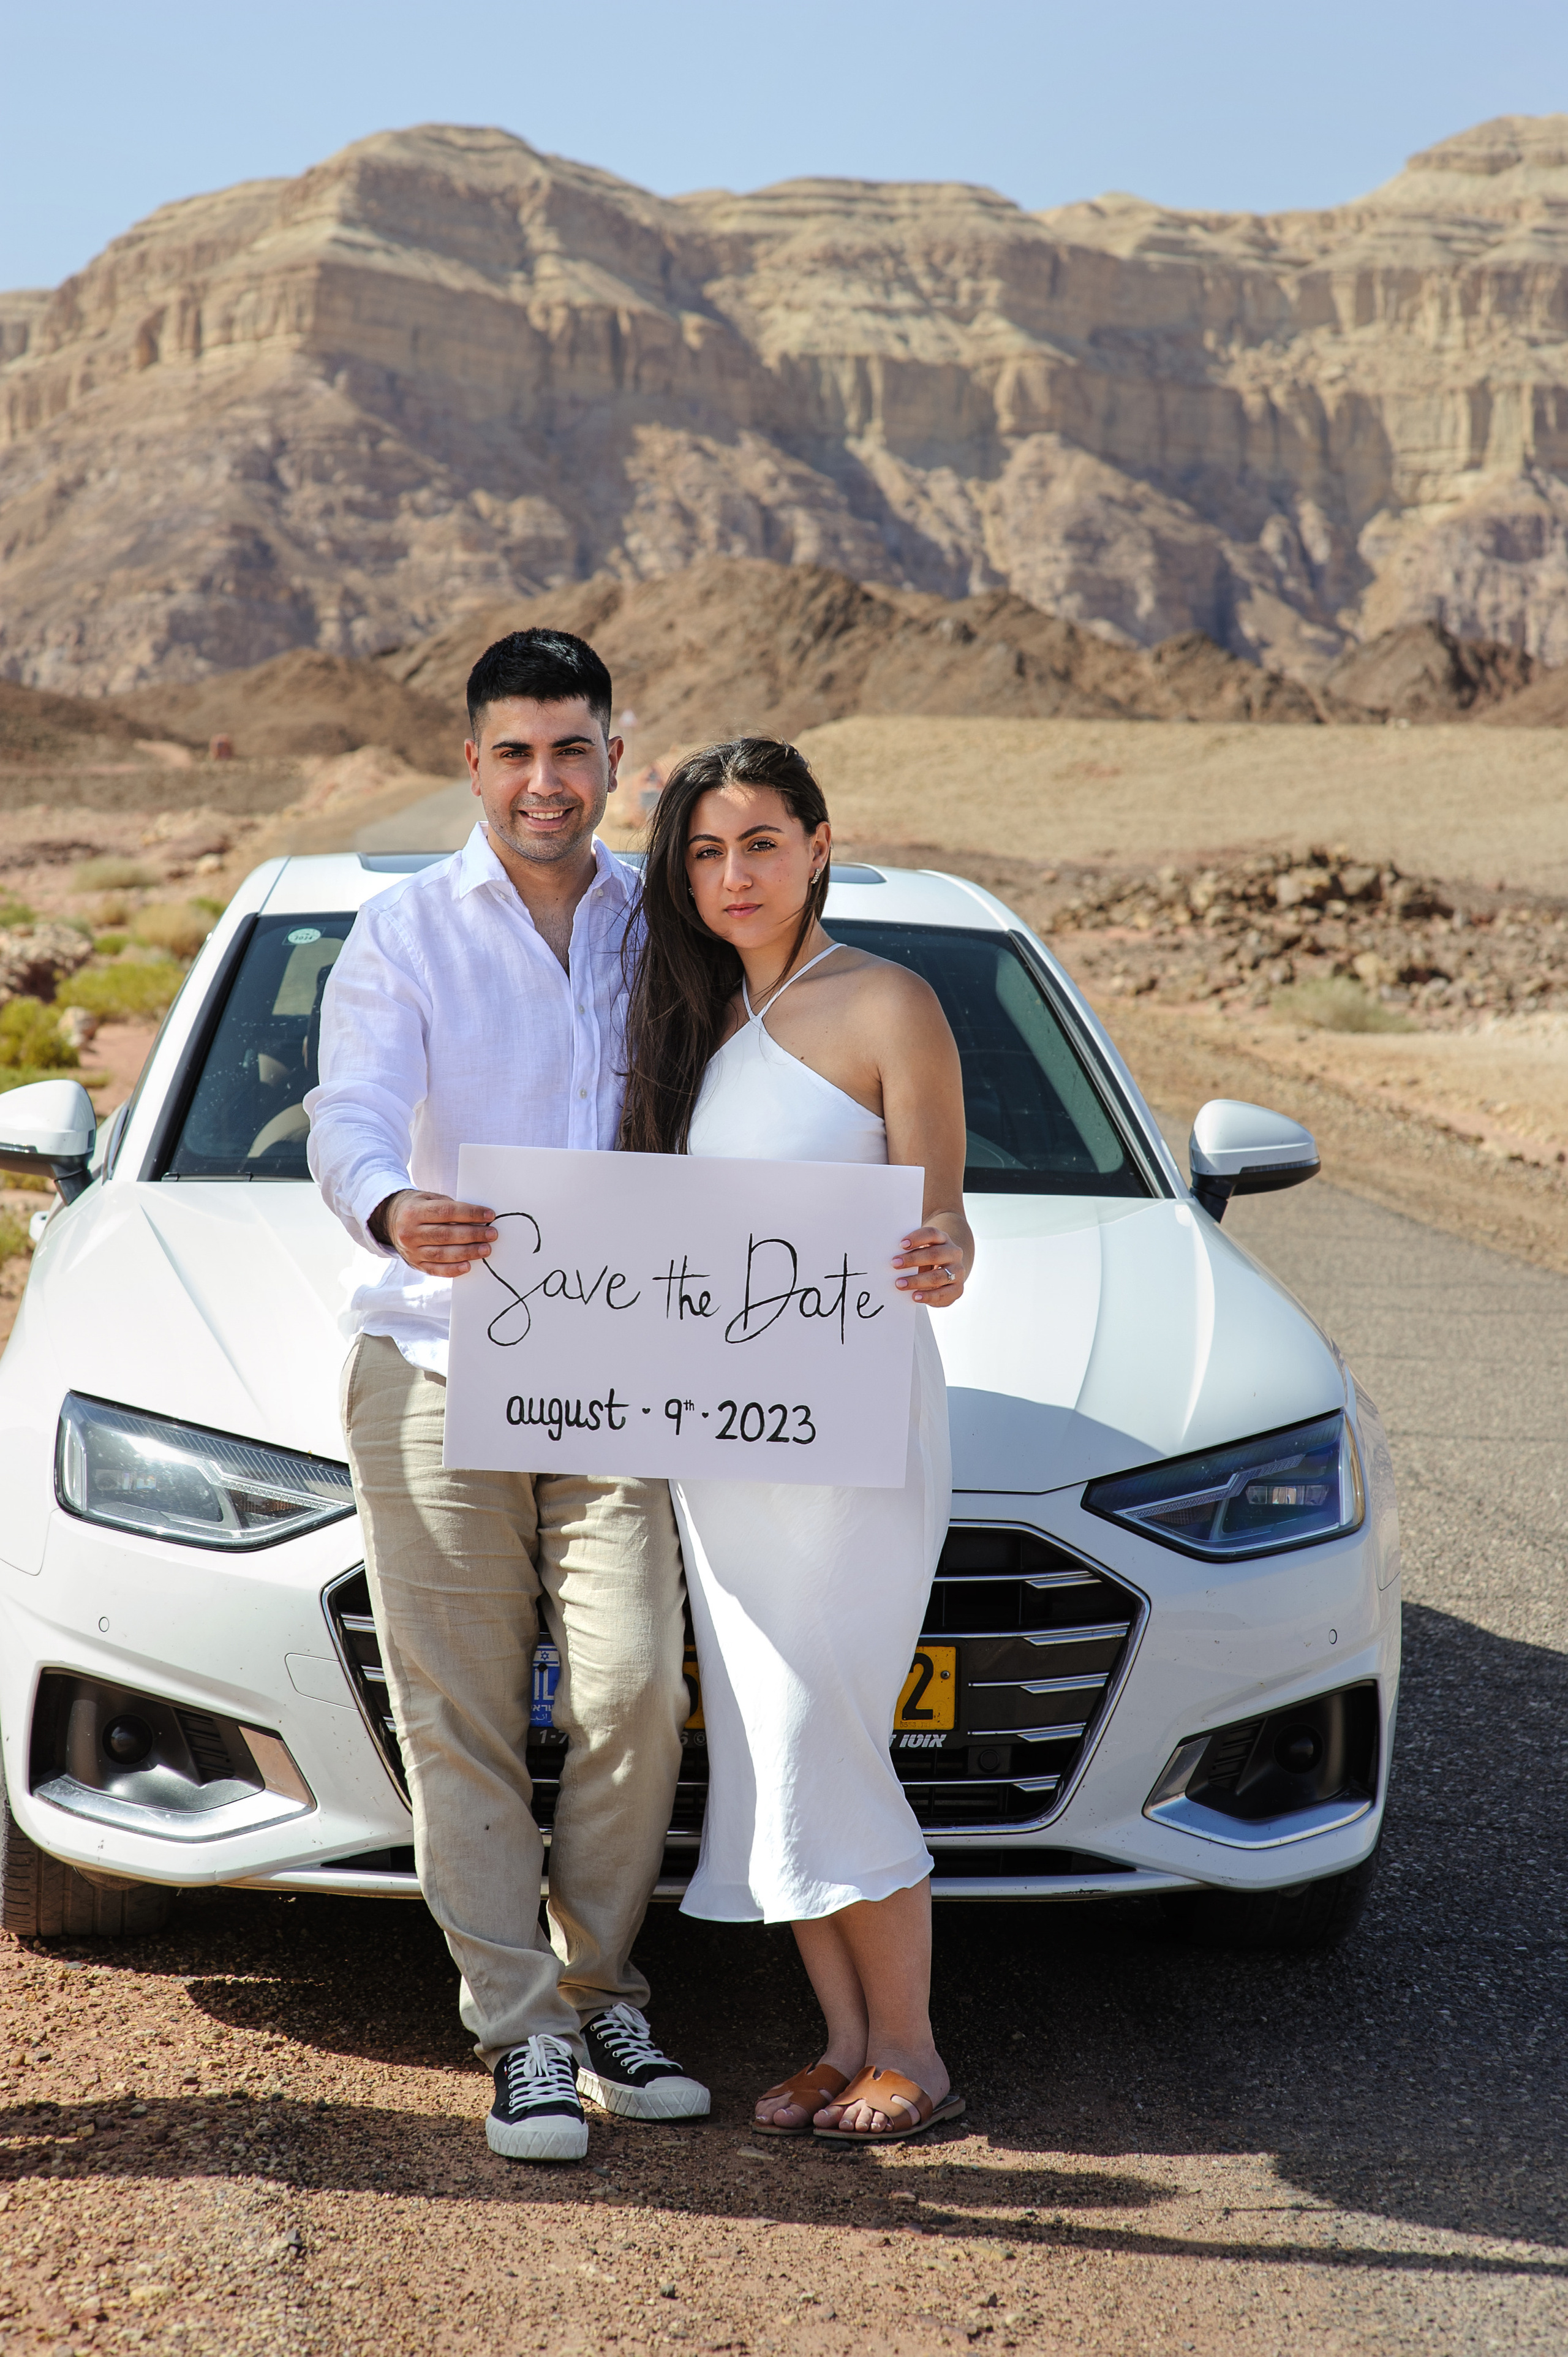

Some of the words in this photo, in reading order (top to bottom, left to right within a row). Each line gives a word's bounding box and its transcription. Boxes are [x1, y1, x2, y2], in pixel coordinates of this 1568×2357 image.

[482, 1211, 641, 1347] Save
[652, 1255, 721, 1320] the
[725, 1233, 885, 1345] Date
[506, 1388, 630, 1441] august
[715, 1399, 816, 1445] 2023
[534, 1668, 554, 1700] IL
